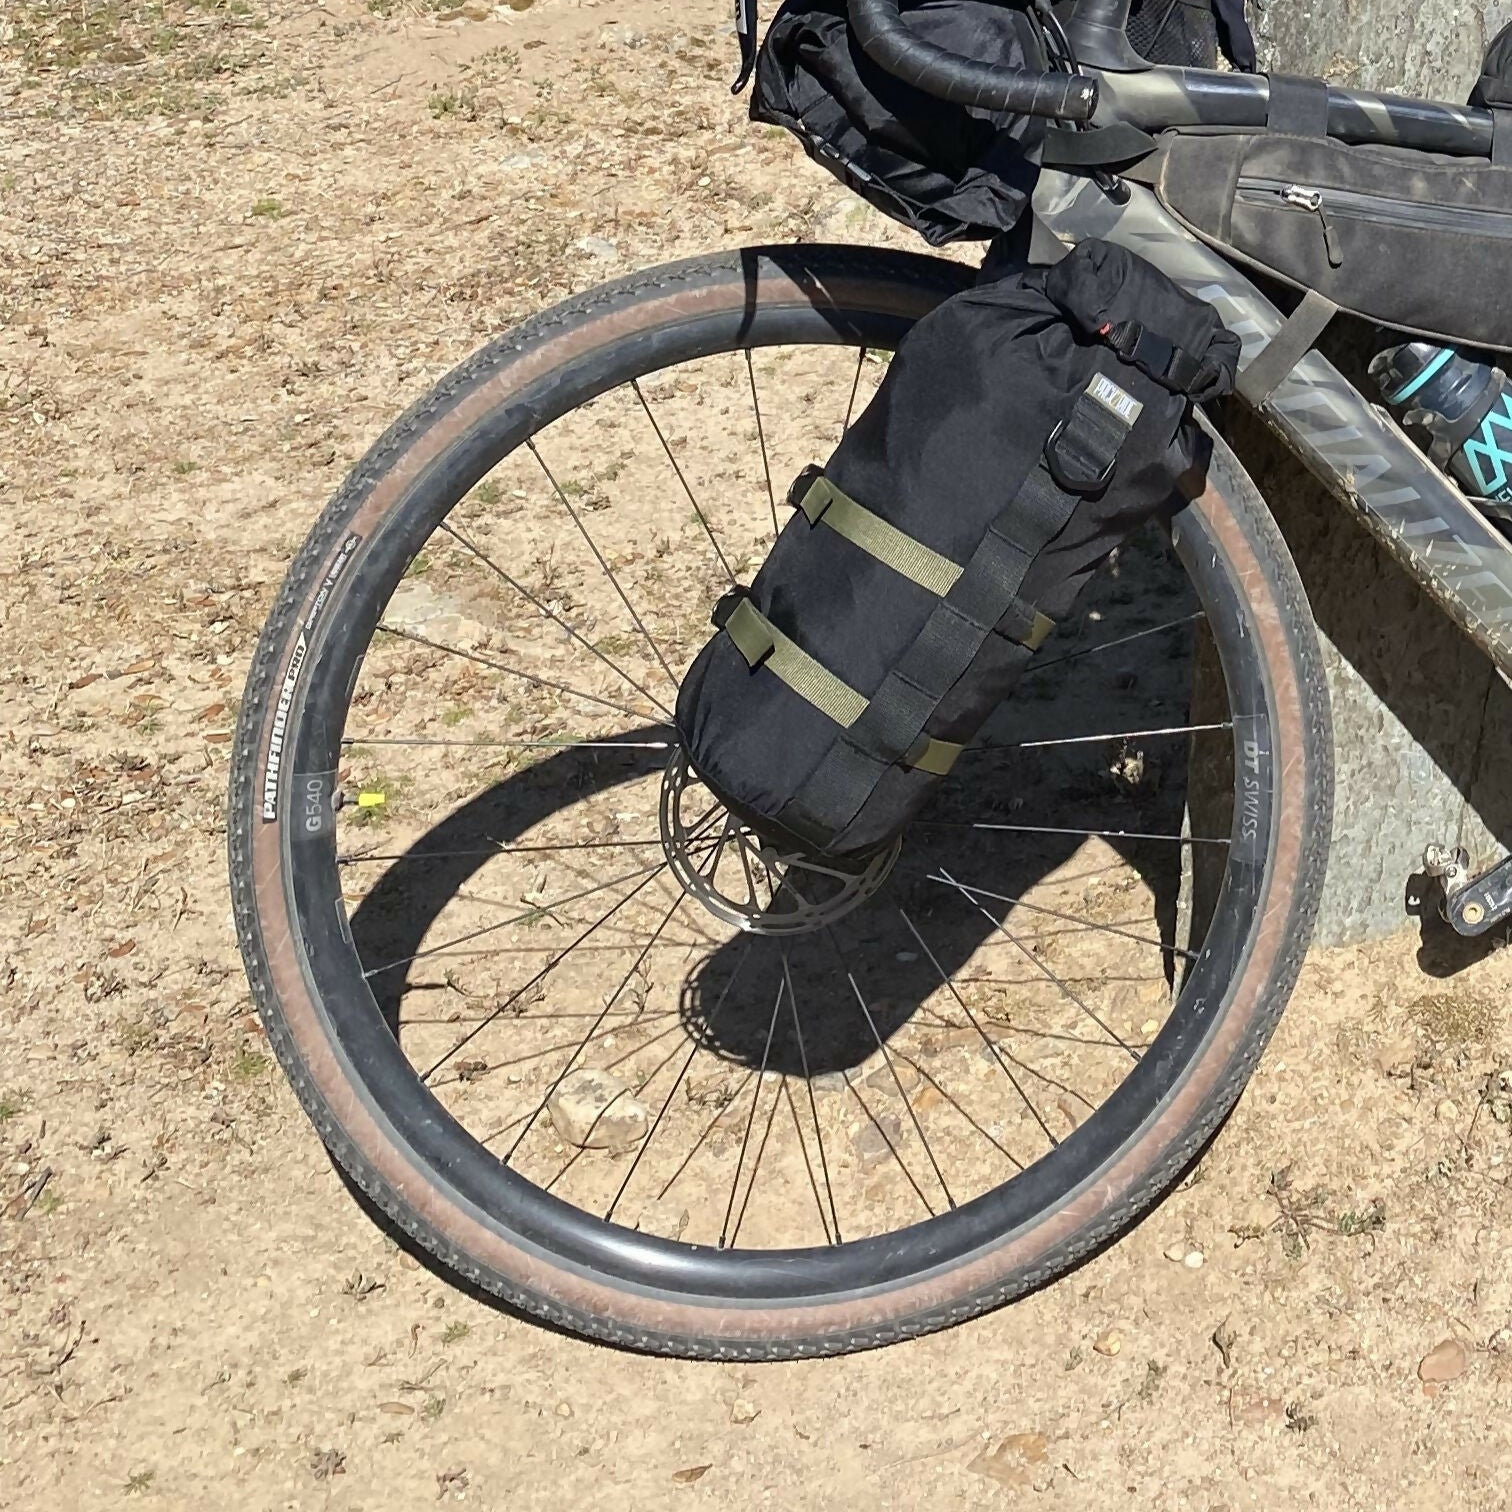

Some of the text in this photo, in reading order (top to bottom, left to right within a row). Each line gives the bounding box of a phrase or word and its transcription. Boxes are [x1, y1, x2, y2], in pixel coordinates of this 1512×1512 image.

[263, 645, 305, 820] PATHFINDER PRO
[306, 779, 323, 832] G540
[1241, 740, 1260, 841] DT SWISS
